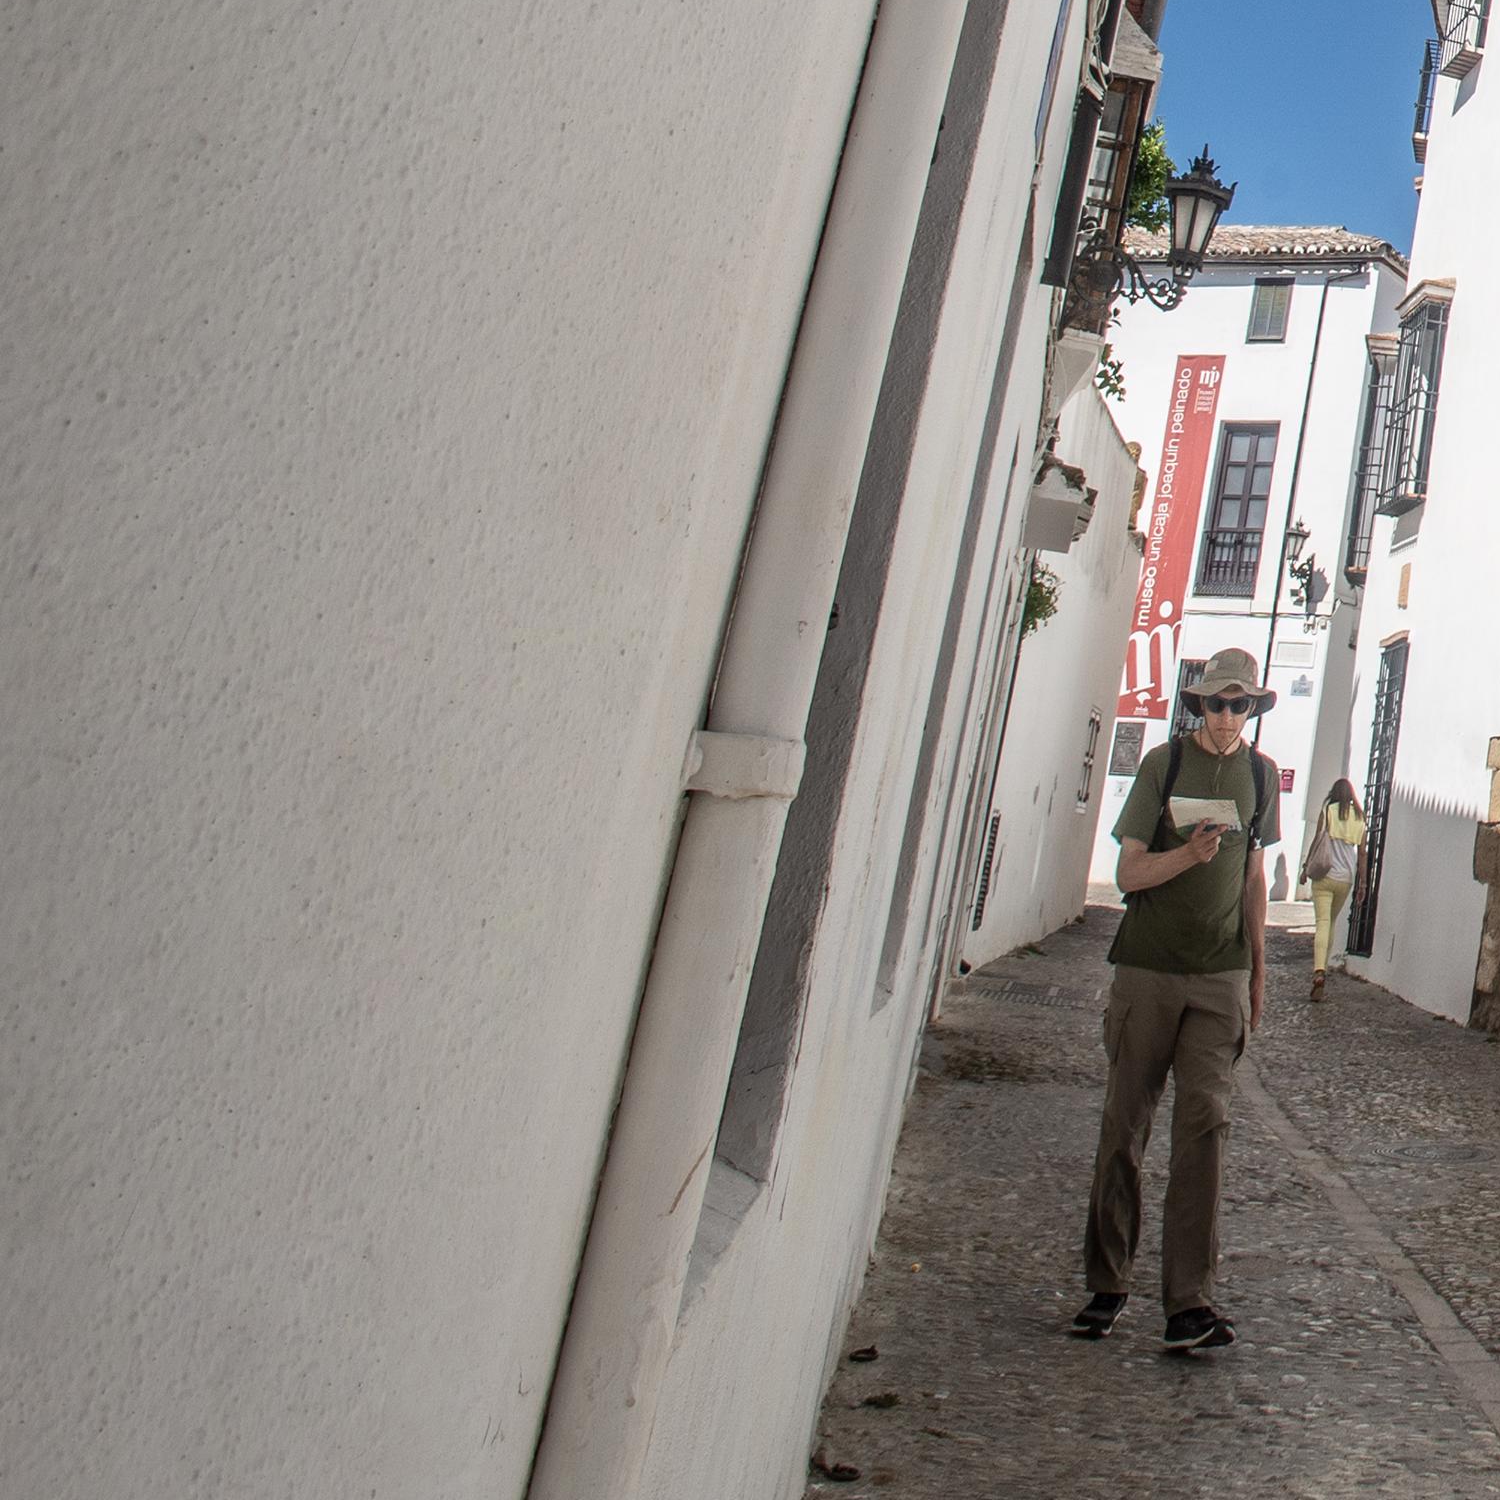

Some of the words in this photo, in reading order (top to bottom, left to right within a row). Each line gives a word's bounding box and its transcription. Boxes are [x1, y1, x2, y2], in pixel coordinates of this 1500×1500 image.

[1171, 368, 1192, 433] peinado
[1157, 438, 1180, 498] joaquín
[1149, 502, 1169, 562] unicaja
[1137, 566, 1157, 626] museo
